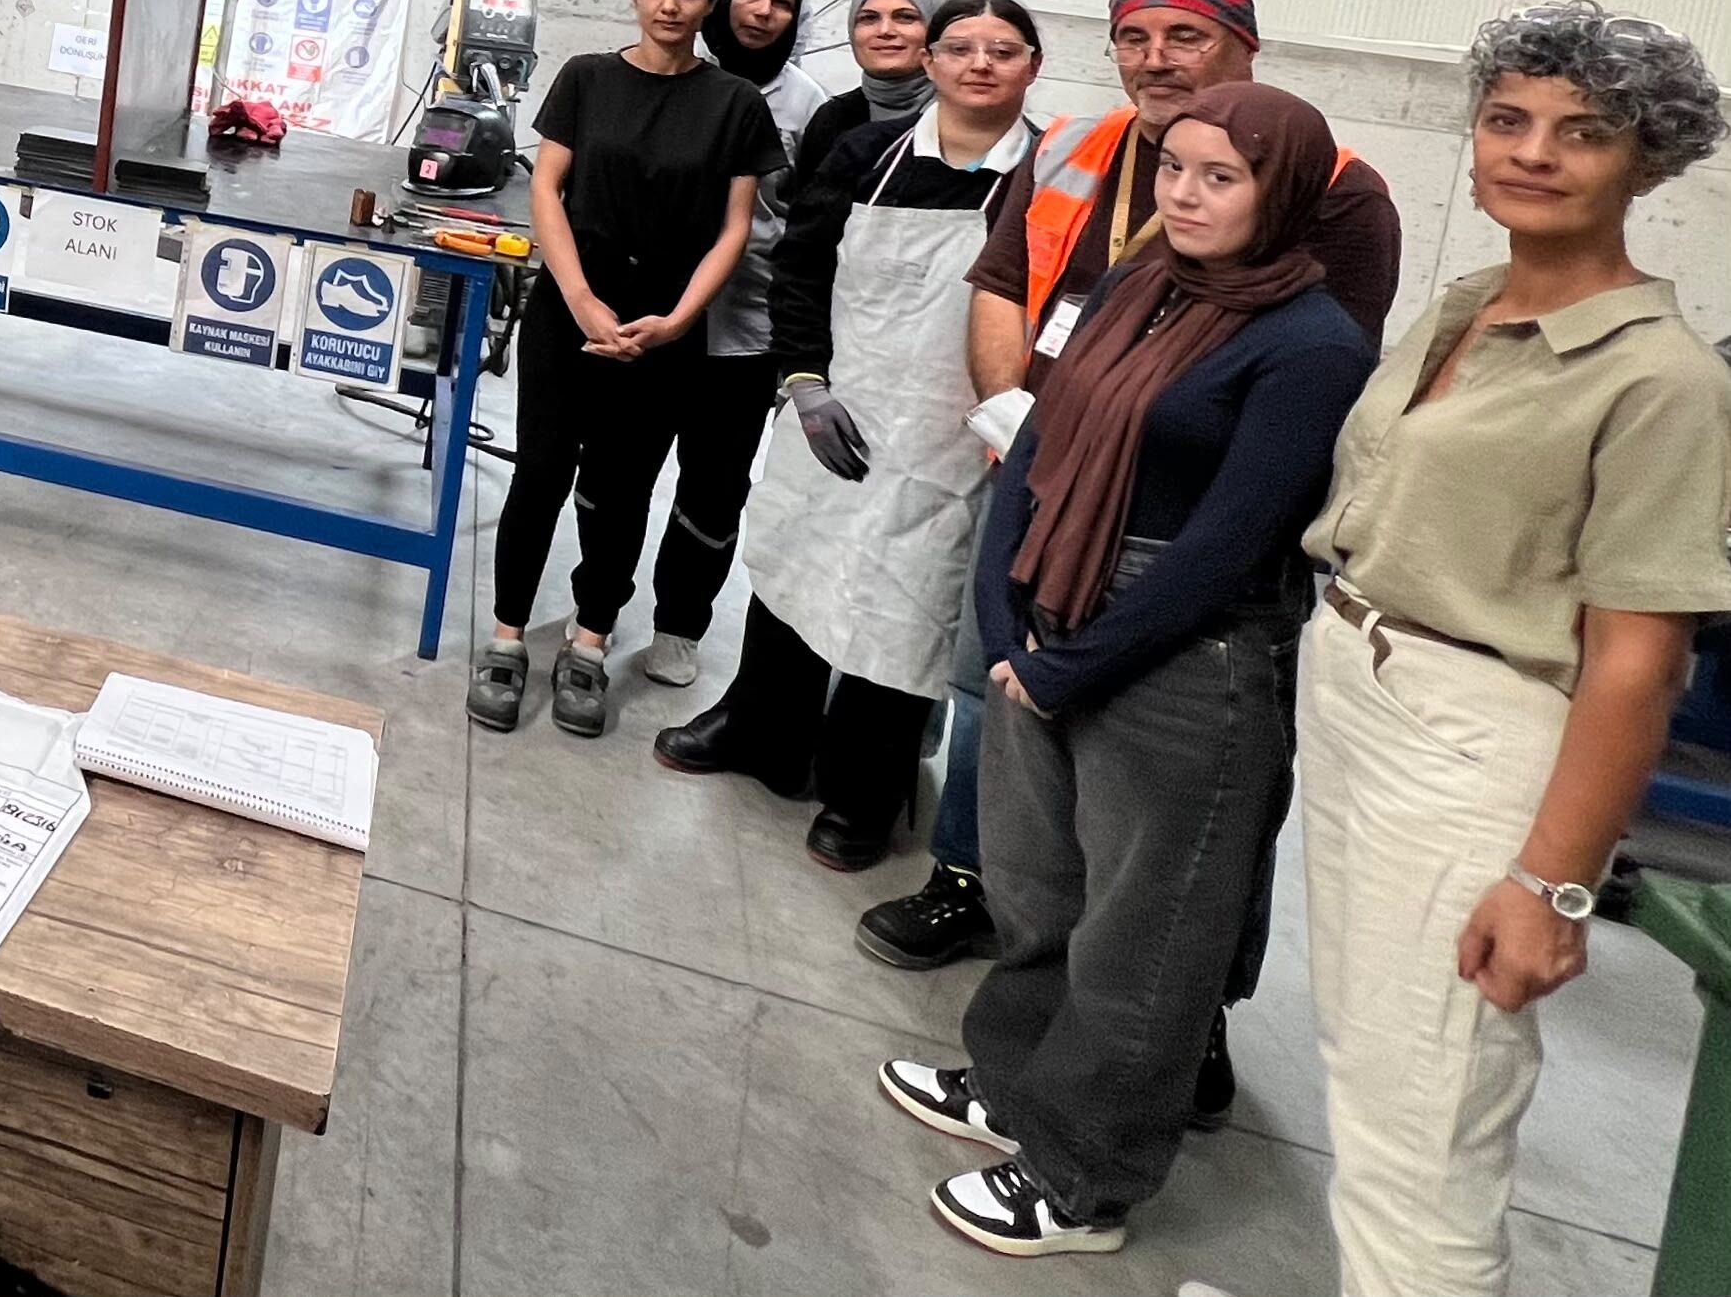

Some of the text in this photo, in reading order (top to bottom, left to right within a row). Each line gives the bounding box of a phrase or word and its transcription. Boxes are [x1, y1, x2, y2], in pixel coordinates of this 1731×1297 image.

[72, 211, 118, 233] STOK
[65, 238, 118, 260] ALANI
[189, 322, 228, 339] KAYNAK
[204, 341, 251, 358] KULLANIN
[311, 334, 381, 361] KORUYUCU
[305, 352, 365, 375] AYAKKABINI
